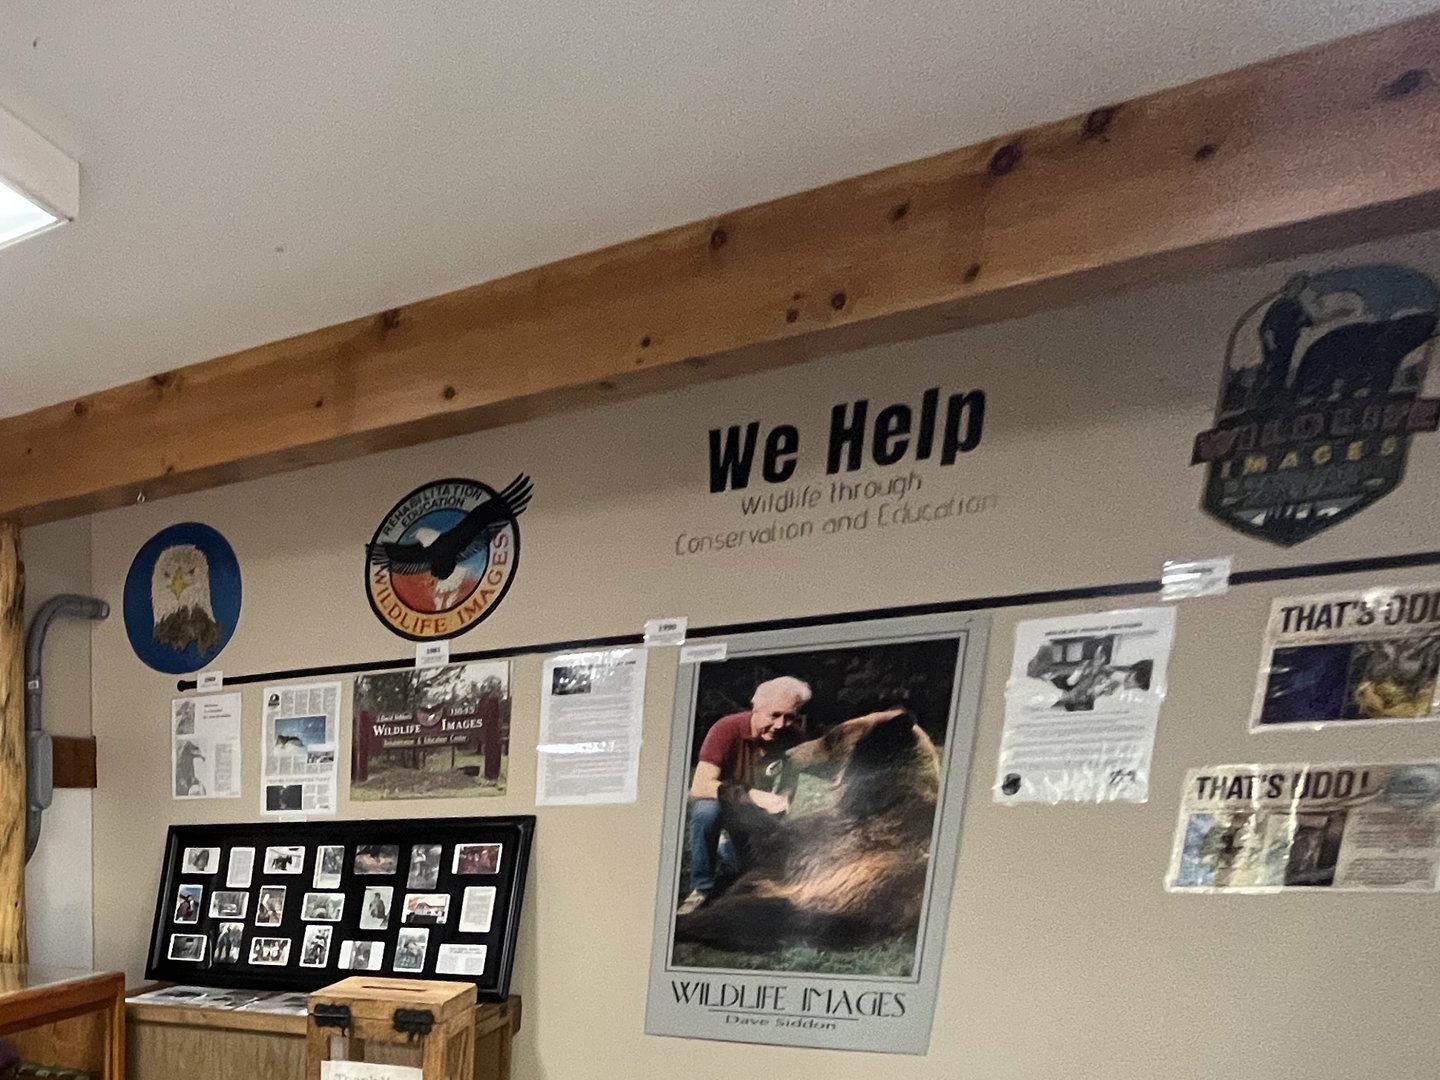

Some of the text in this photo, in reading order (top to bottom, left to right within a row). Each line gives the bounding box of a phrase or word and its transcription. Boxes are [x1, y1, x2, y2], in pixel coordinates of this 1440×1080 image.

[709, 386, 987, 493] We Help
[382, 484, 483, 536] REHABILITATION
[401, 498, 465, 528] EDUCATION
[741, 472, 922, 516] Wildlife through
[675, 493, 1000, 556] Conservation and Education
[373, 533, 510, 634] WILDLIFE IMAGES
[1280, 600, 1375, 633] THAT'S
[373, 719, 483, 736] WILDLIFE IMAGES
[671, 979, 907, 1017] WILDLIFE IMAGES
[724, 1013, 837, 1031] Dave Siddon
